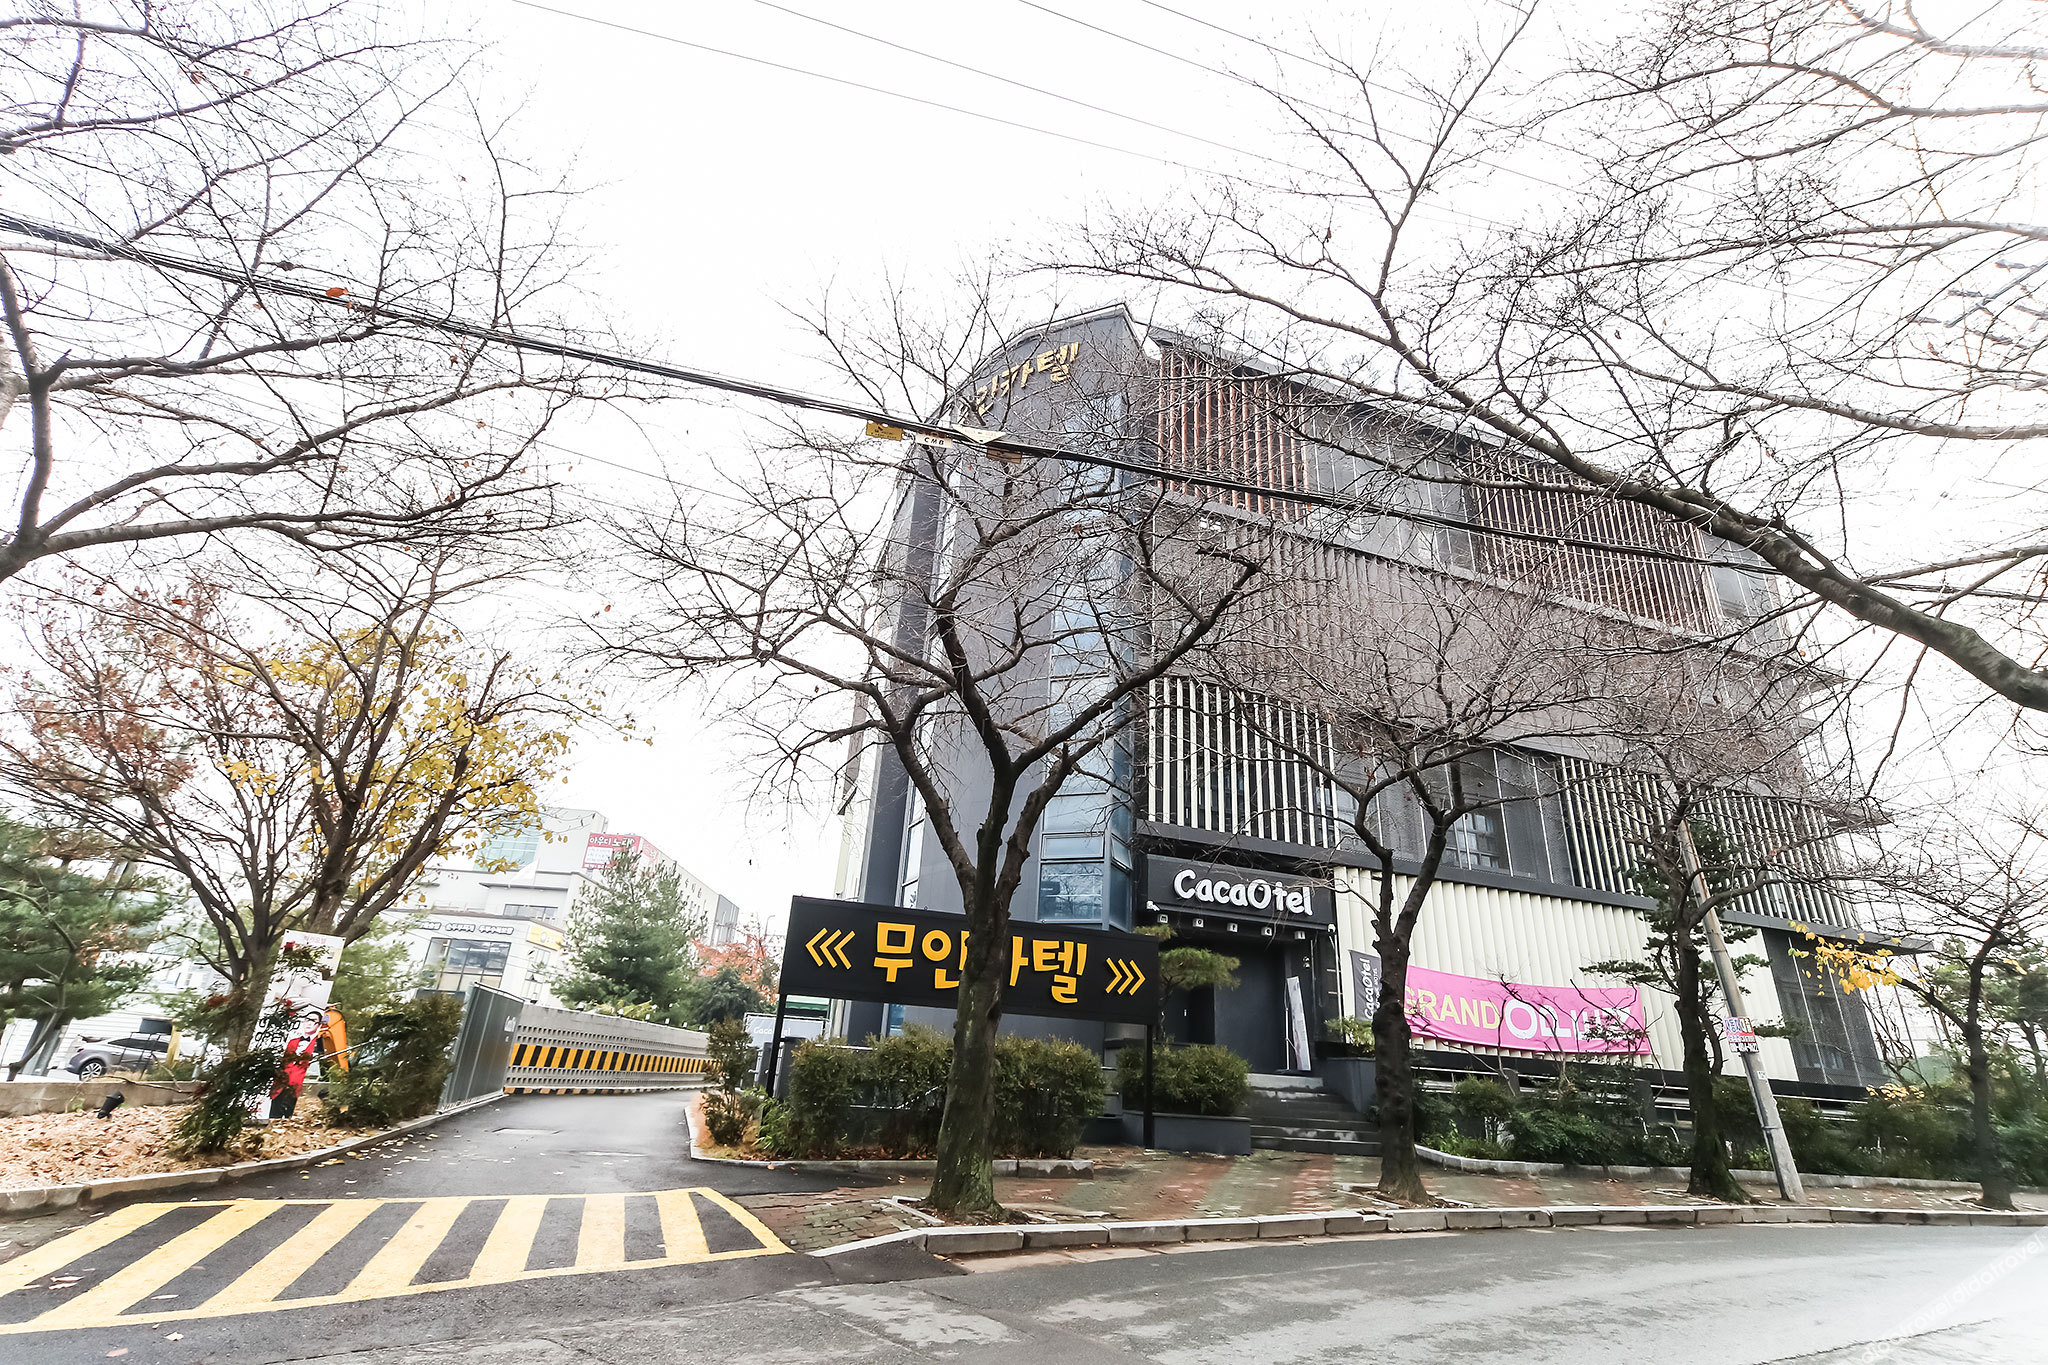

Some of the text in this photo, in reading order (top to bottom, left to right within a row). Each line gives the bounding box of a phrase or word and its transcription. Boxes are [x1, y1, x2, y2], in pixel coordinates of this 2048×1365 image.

[1173, 869, 1313, 916] CacaOtel
[873, 921, 1088, 1004] 무인텔
[1360, 957, 1374, 1019] CacaOtel
